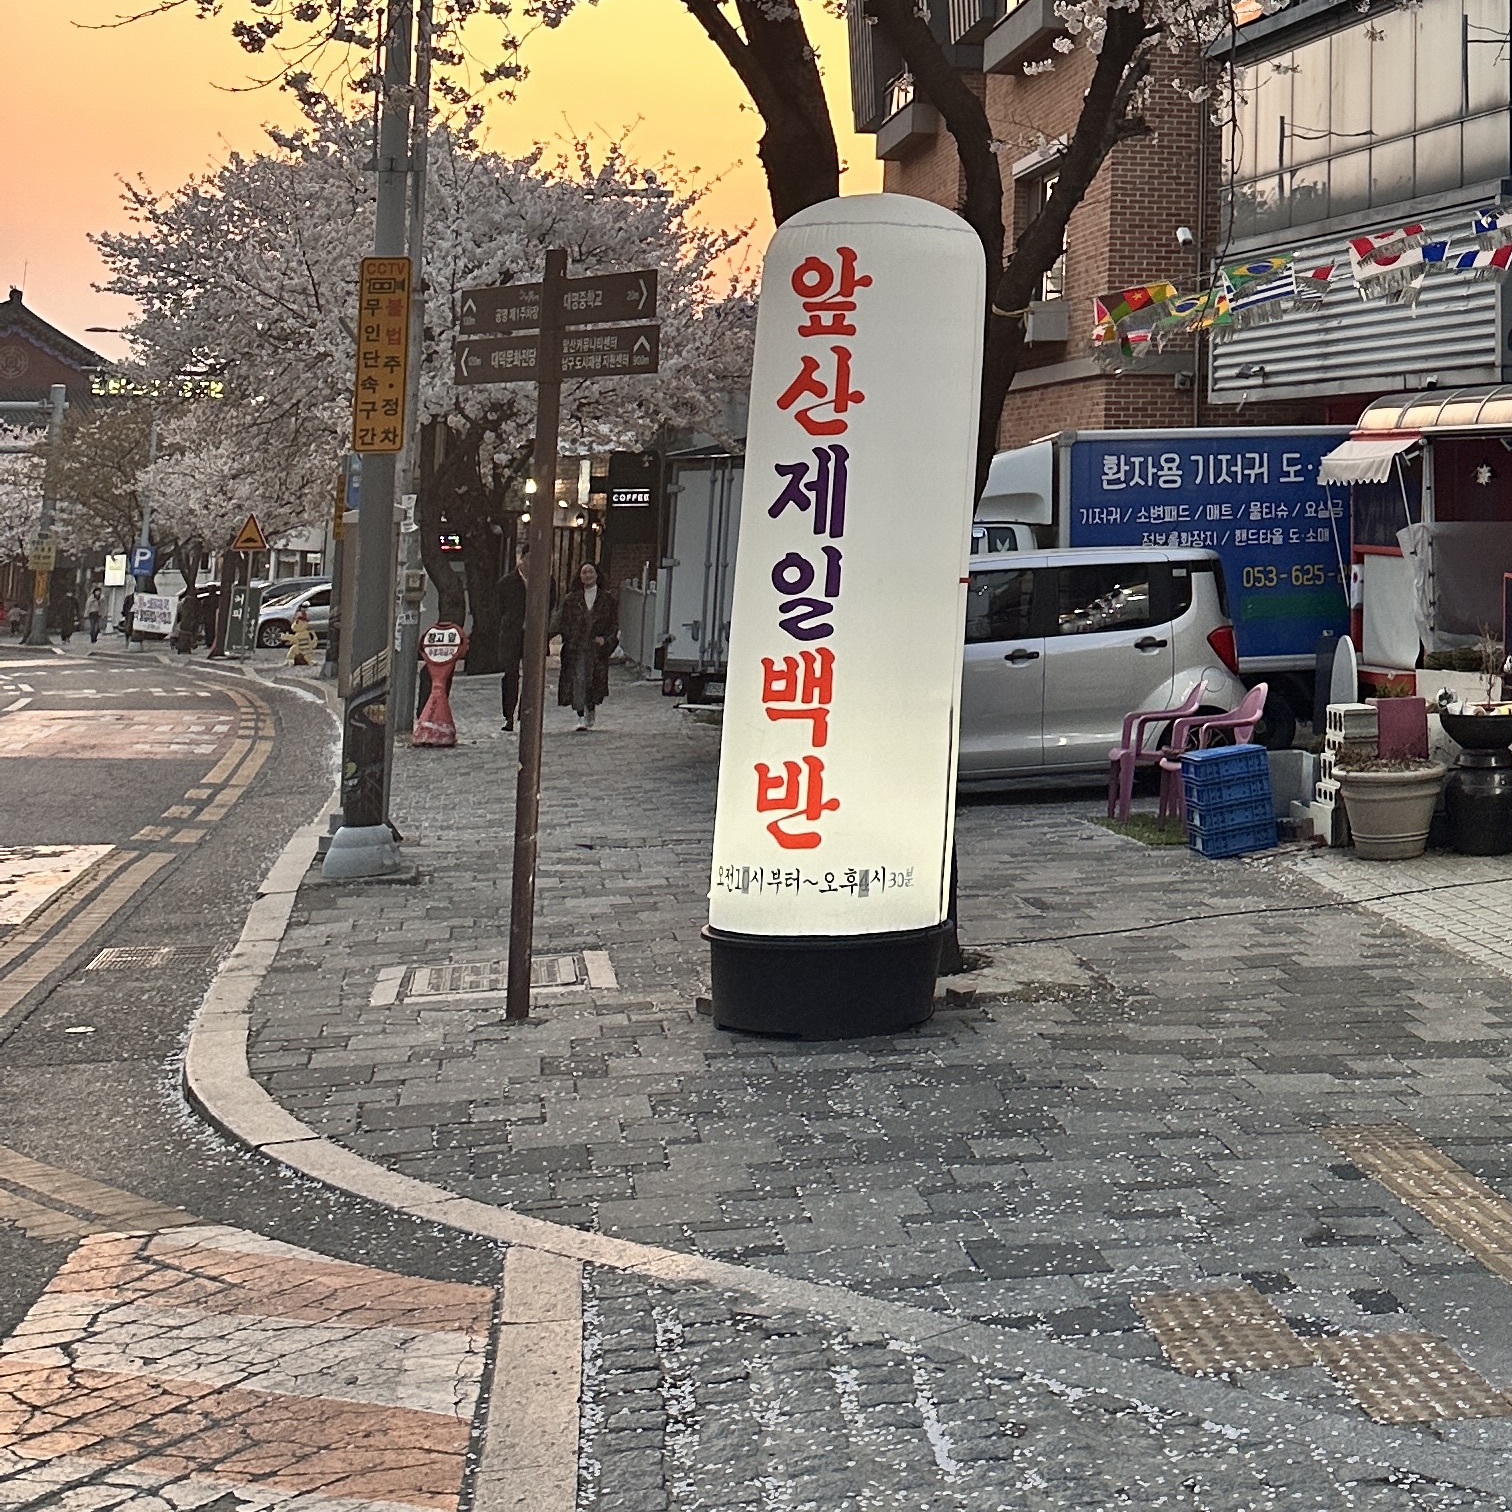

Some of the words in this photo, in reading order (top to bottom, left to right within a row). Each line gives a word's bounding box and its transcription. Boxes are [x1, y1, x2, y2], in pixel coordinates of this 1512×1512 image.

[366, 262, 407, 276] CCTV
[563, 289, 603, 311] 대명중학교
[1101, 453, 1183, 490] 환자용
[1190, 452, 1269, 485] 기저귀
[612, 493, 650, 502] COFFEE
[1079, 506, 1121, 526] 기저귀
[1136, 504, 1192, 524] 소변패드
[1206, 503, 1234, 520] 매트
[1249, 501, 1289, 520] 물티슈
[1242, 563, 1351, 589] 053-625-2
